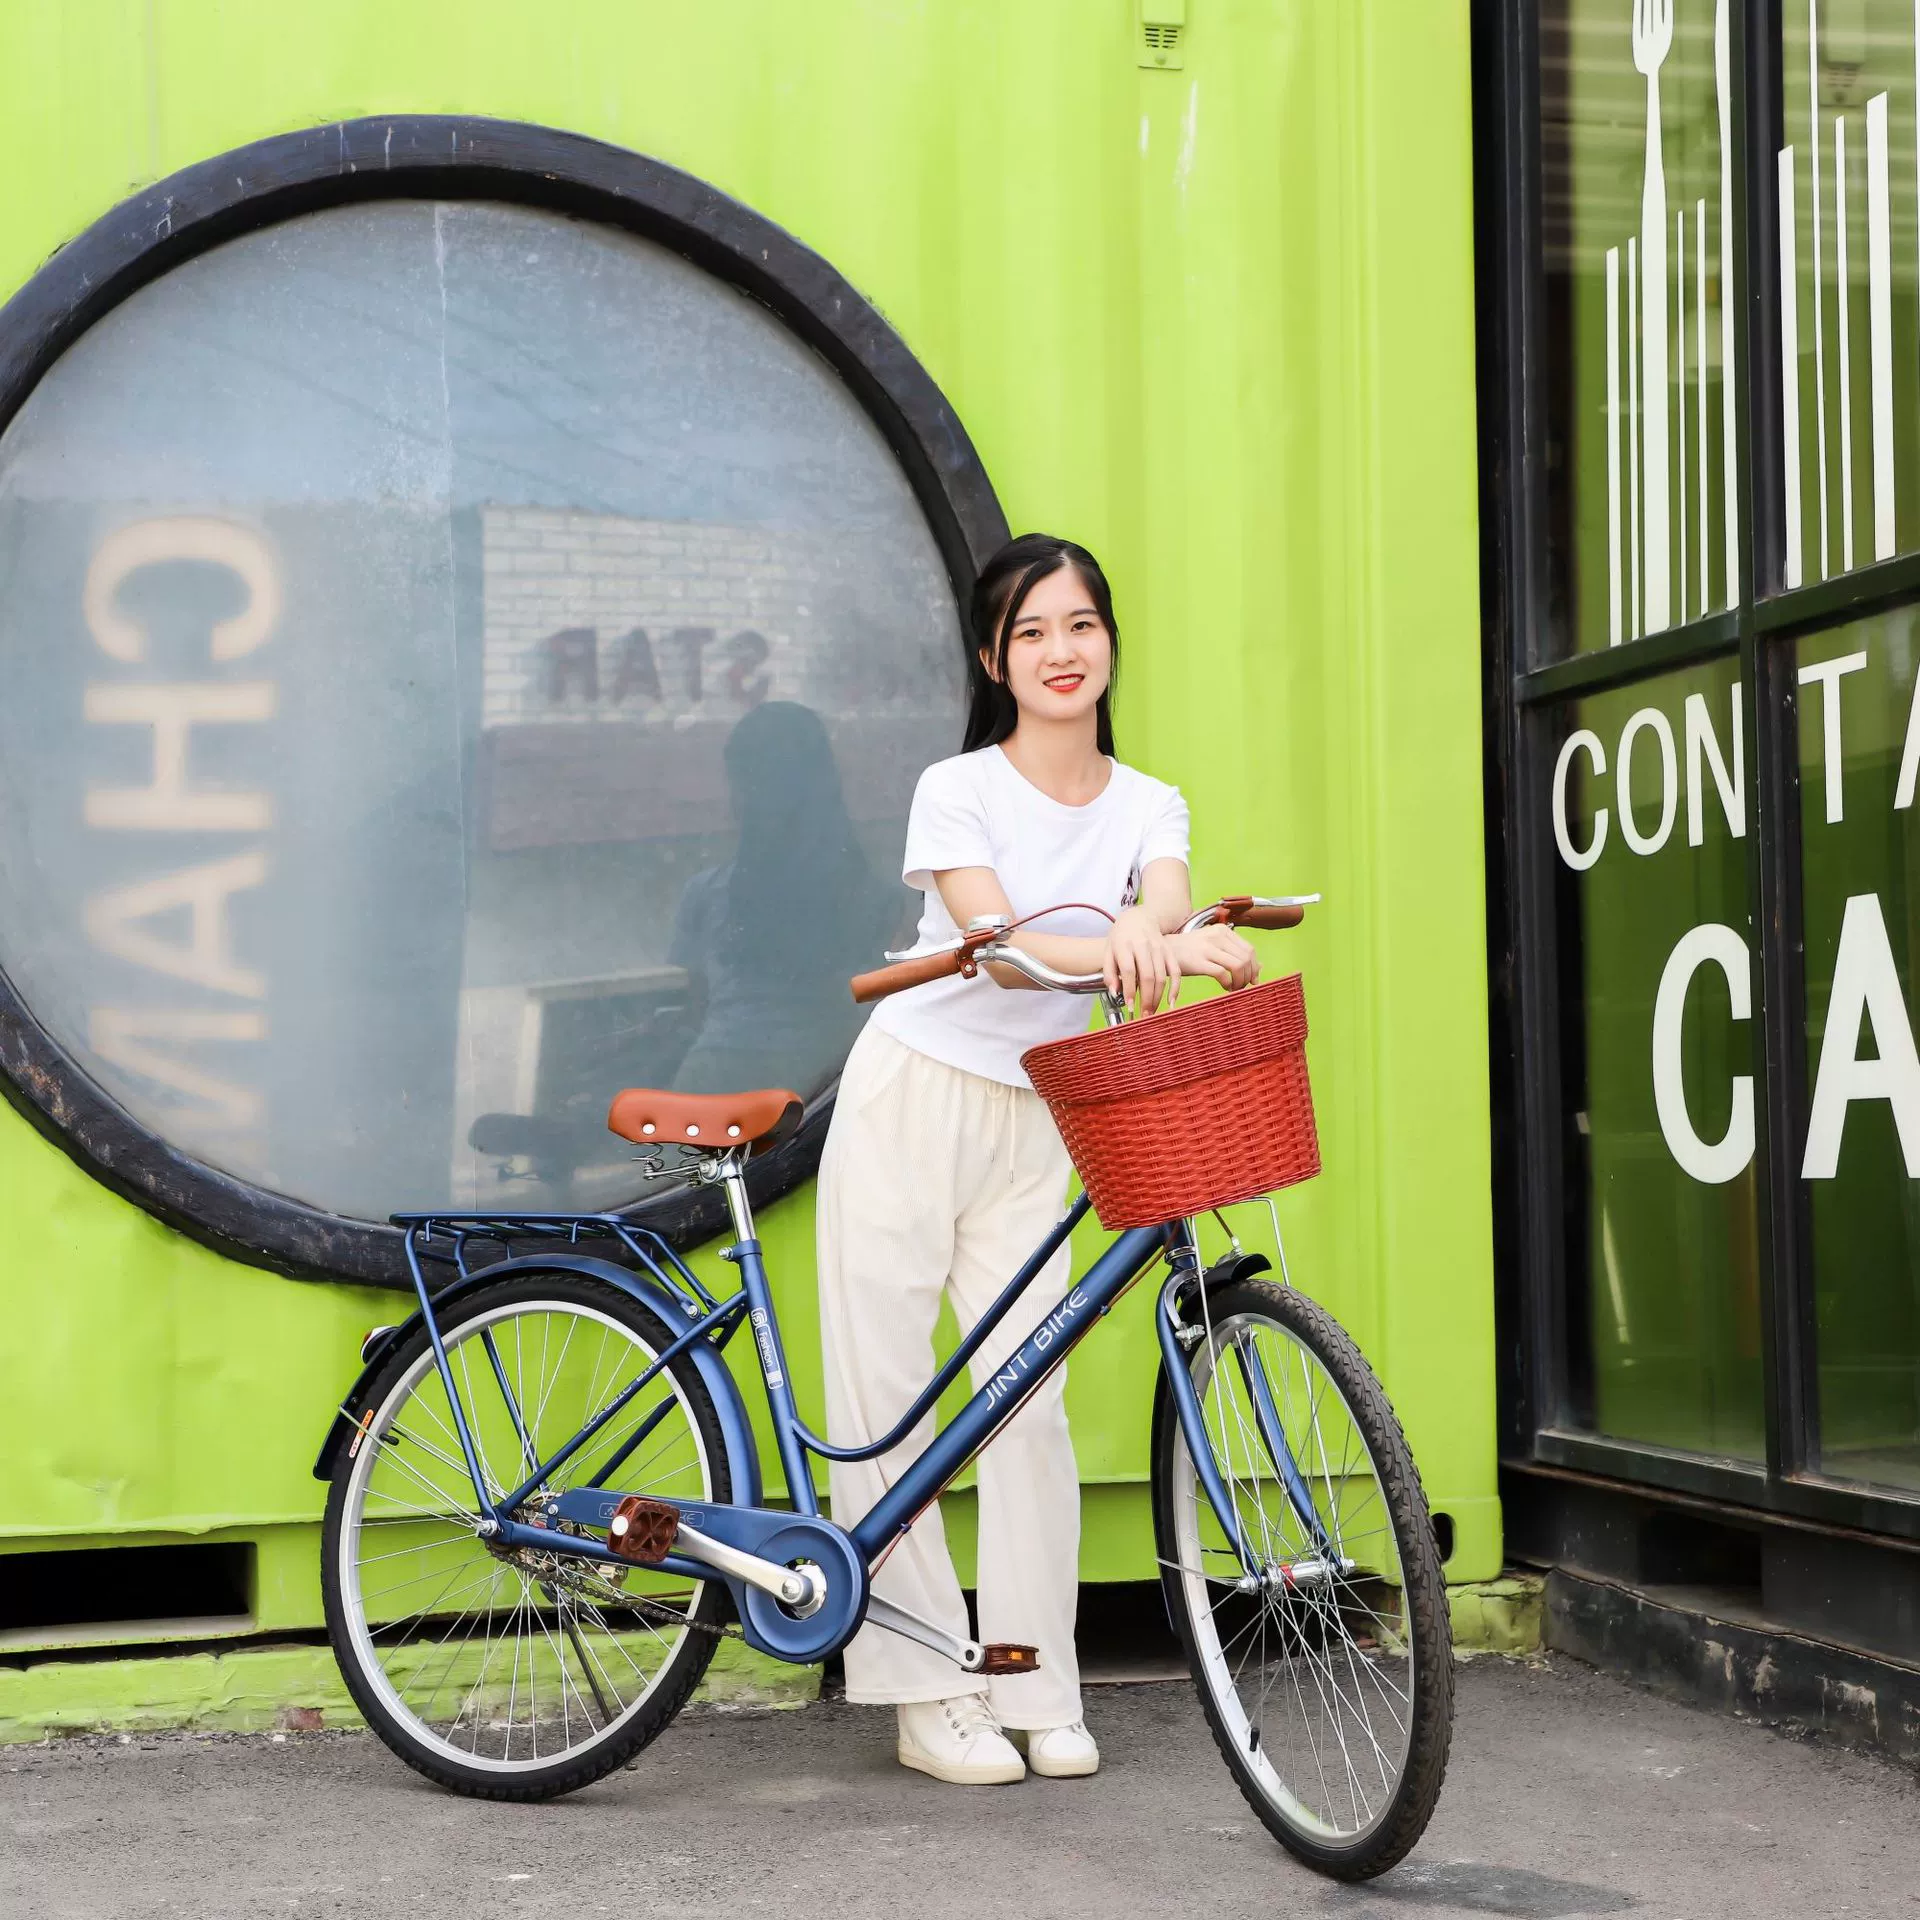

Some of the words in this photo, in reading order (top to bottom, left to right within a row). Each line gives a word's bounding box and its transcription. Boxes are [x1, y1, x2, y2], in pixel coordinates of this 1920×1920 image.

[759, 1331, 774, 1367] Fashion
[986, 1347, 1028, 1411] JINT
[1034, 1286, 1088, 1351] BIKE
